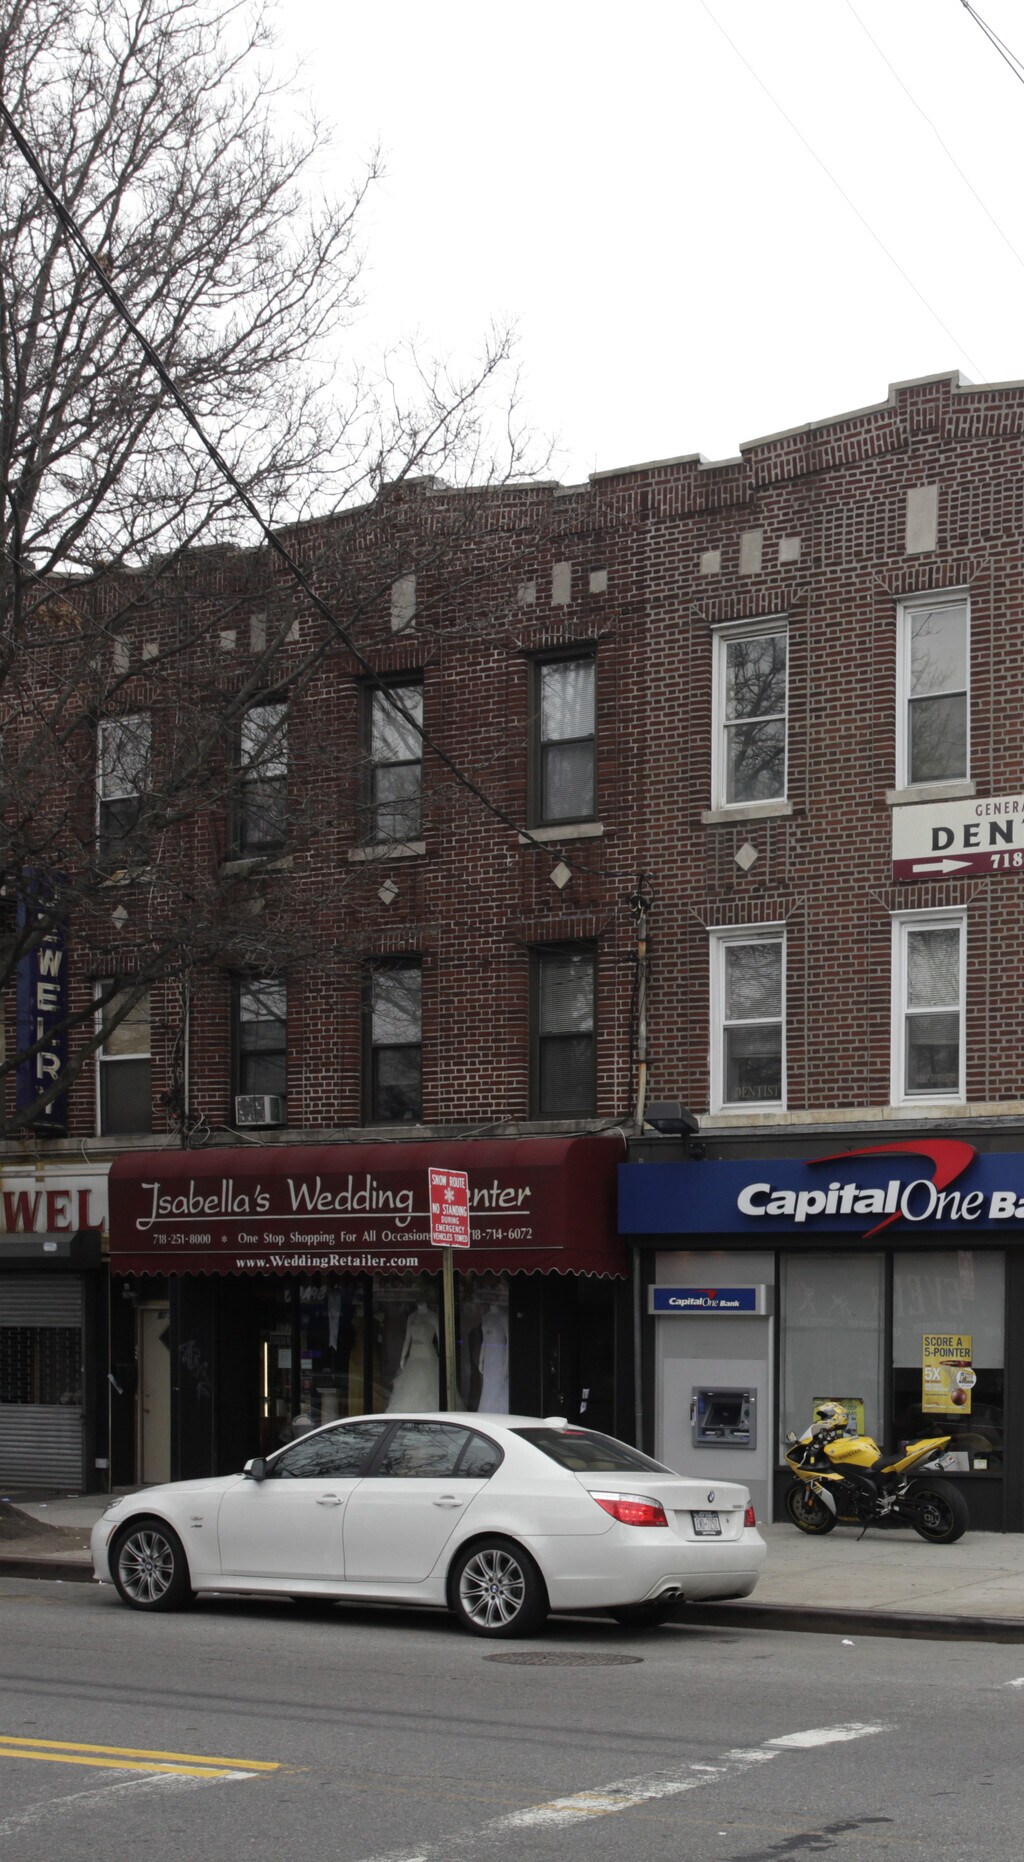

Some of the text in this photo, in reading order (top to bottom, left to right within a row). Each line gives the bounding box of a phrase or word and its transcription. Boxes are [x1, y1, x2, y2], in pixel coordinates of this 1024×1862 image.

[736, 1085, 780, 1098] DENTIST
[432, 1174, 465, 1188] SNOW ROUTE
[287, 1174, 413, 1227] Wedding
[468, 1180, 531, 1208] nter
[432, 1203, 467, 1217] NO STANDING
[441, 1215, 459, 1224] DURING
[436, 1223, 465, 1234] EMERGENCY
[153, 1233, 211, 1245] 718-251-8000
[238, 1233, 259, 1243] One
[263, 1232, 285, 1246] Stop
[290, 1231, 335, 1246] Shopping
[340, 1231, 356, 1242] For
[362, 1230, 376, 1242] All
[432, 1232, 469, 1243] VEHICLES TOWED
[236, 1254, 419, 1269] www.WeddingRetailer.com
[924, 1336, 963, 1347] SCORE A
[924, 1347, 971, 1358] 5-POINTER
[924, 1367, 941, 1380] 5X
